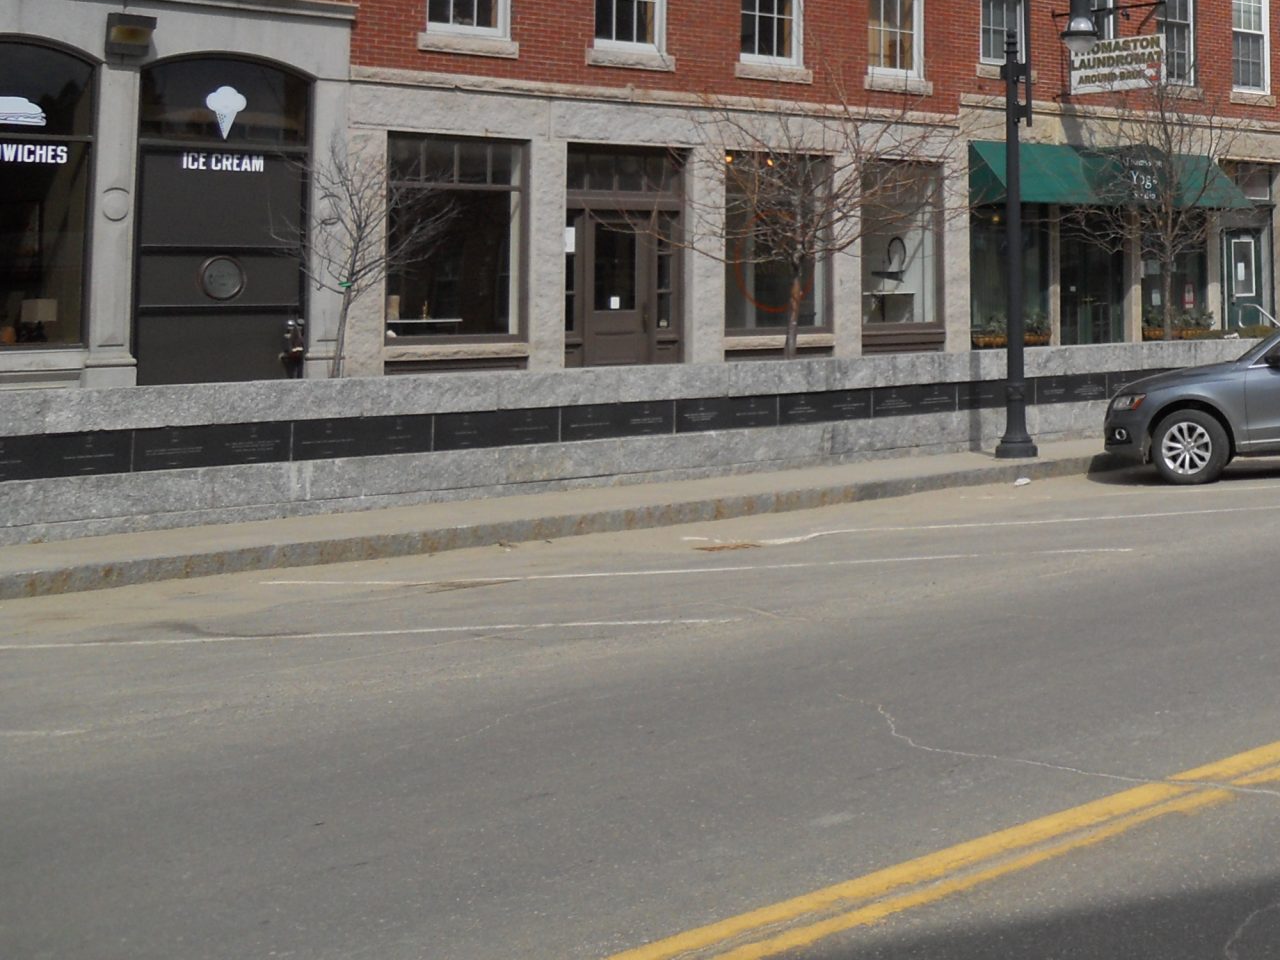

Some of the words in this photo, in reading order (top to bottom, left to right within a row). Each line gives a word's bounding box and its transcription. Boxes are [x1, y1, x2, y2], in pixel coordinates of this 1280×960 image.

[1071, 50, 1161, 71] LAUNDROMAT
[0, 144, 68, 164] WICHES
[182, 152, 208, 170] ICE
[211, 153, 265, 172] CREAM
